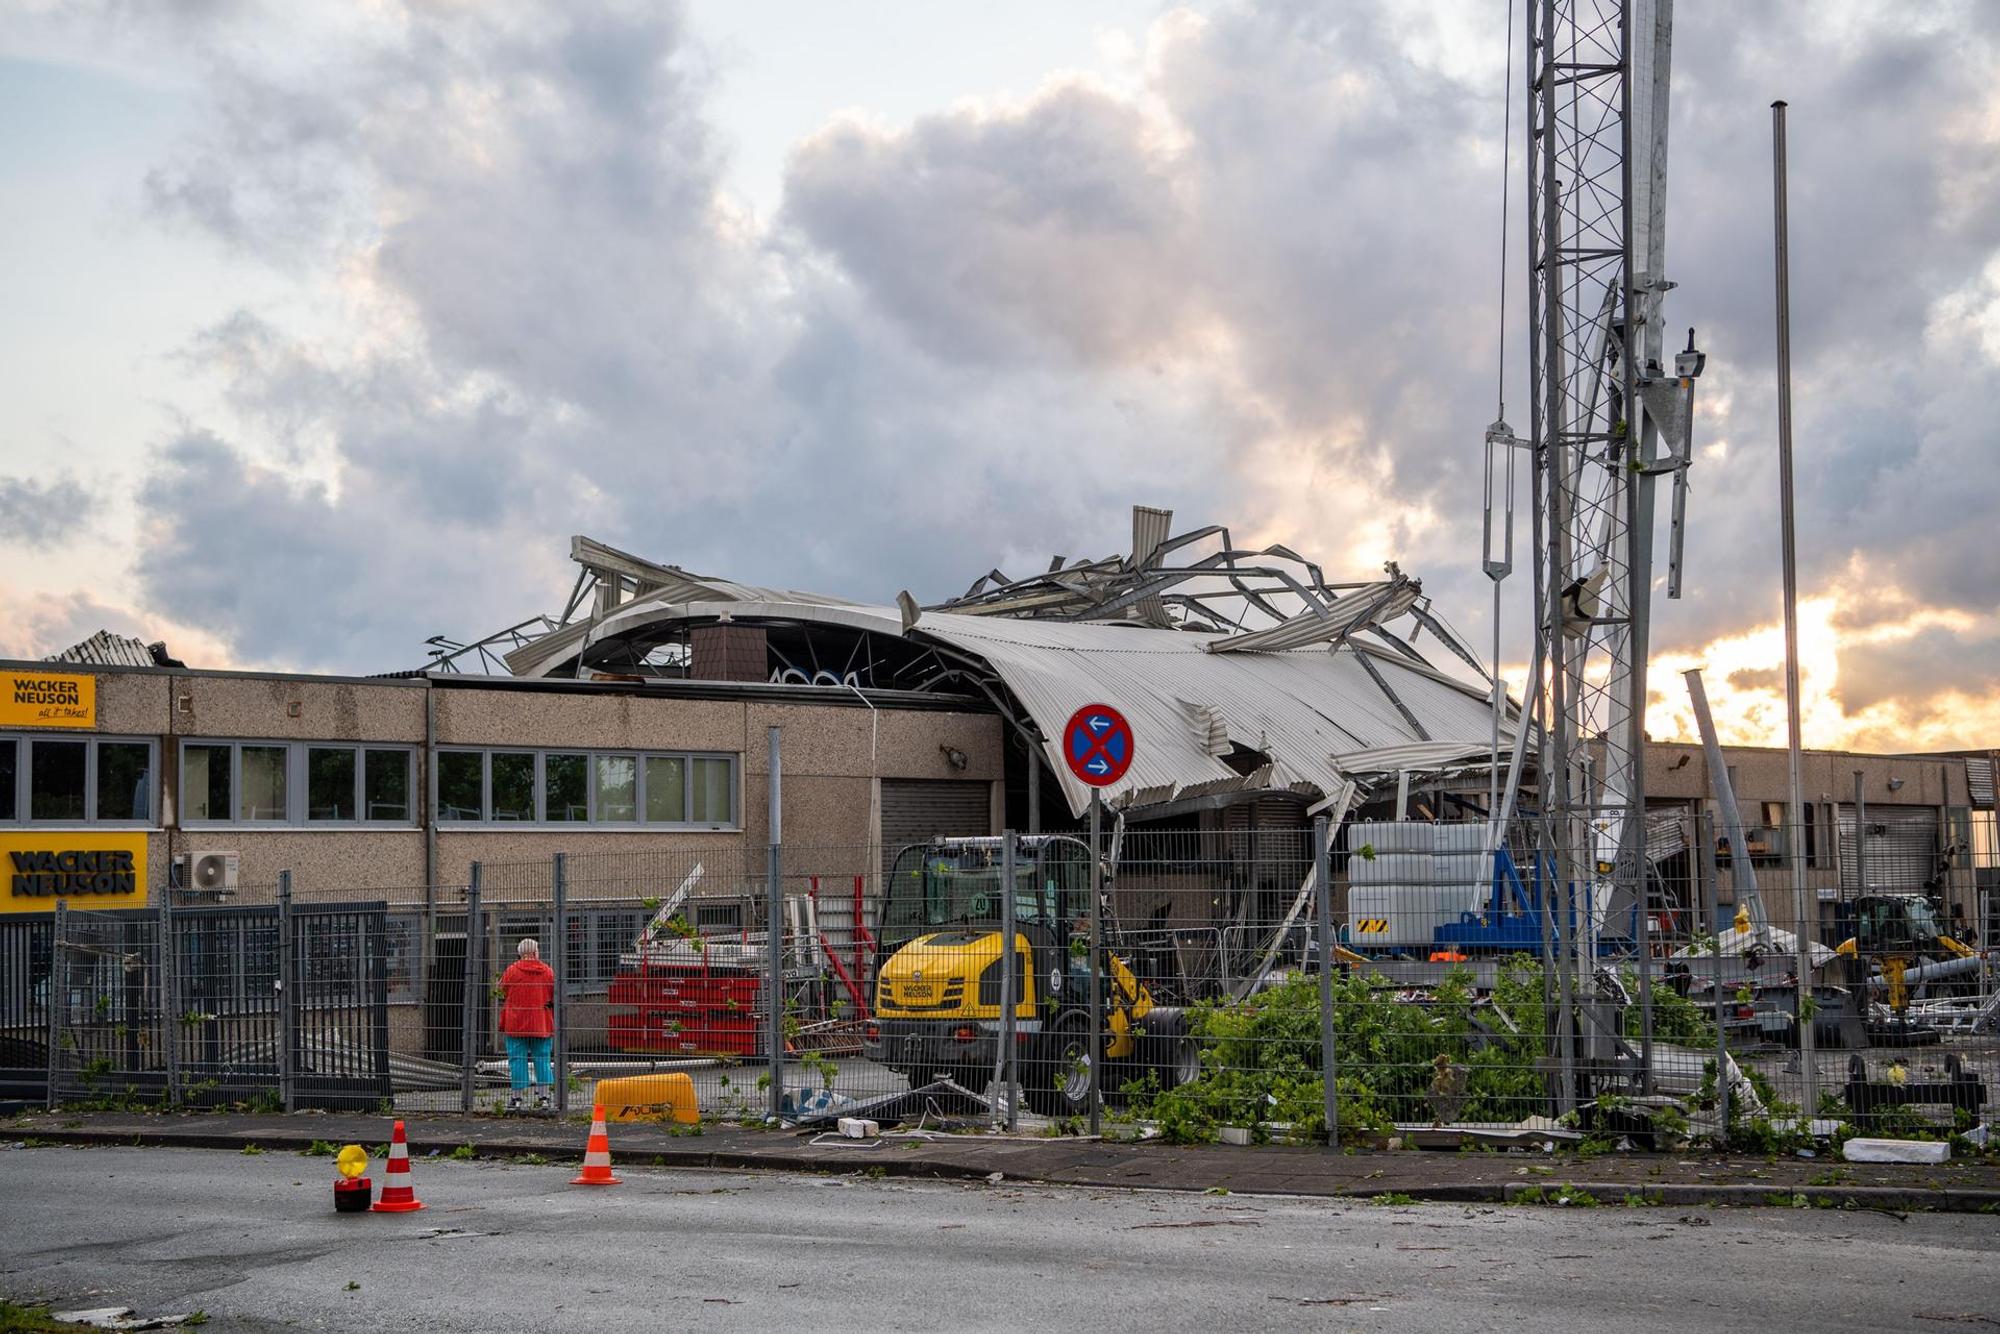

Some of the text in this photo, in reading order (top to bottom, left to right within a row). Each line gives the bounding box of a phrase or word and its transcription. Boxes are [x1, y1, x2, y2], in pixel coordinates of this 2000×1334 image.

[13, 679, 78, 692] WACKER
[14, 692, 79, 705] NEUSON
[9, 850, 135, 872] WACKER
[11, 872, 136, 897] NEUSON
